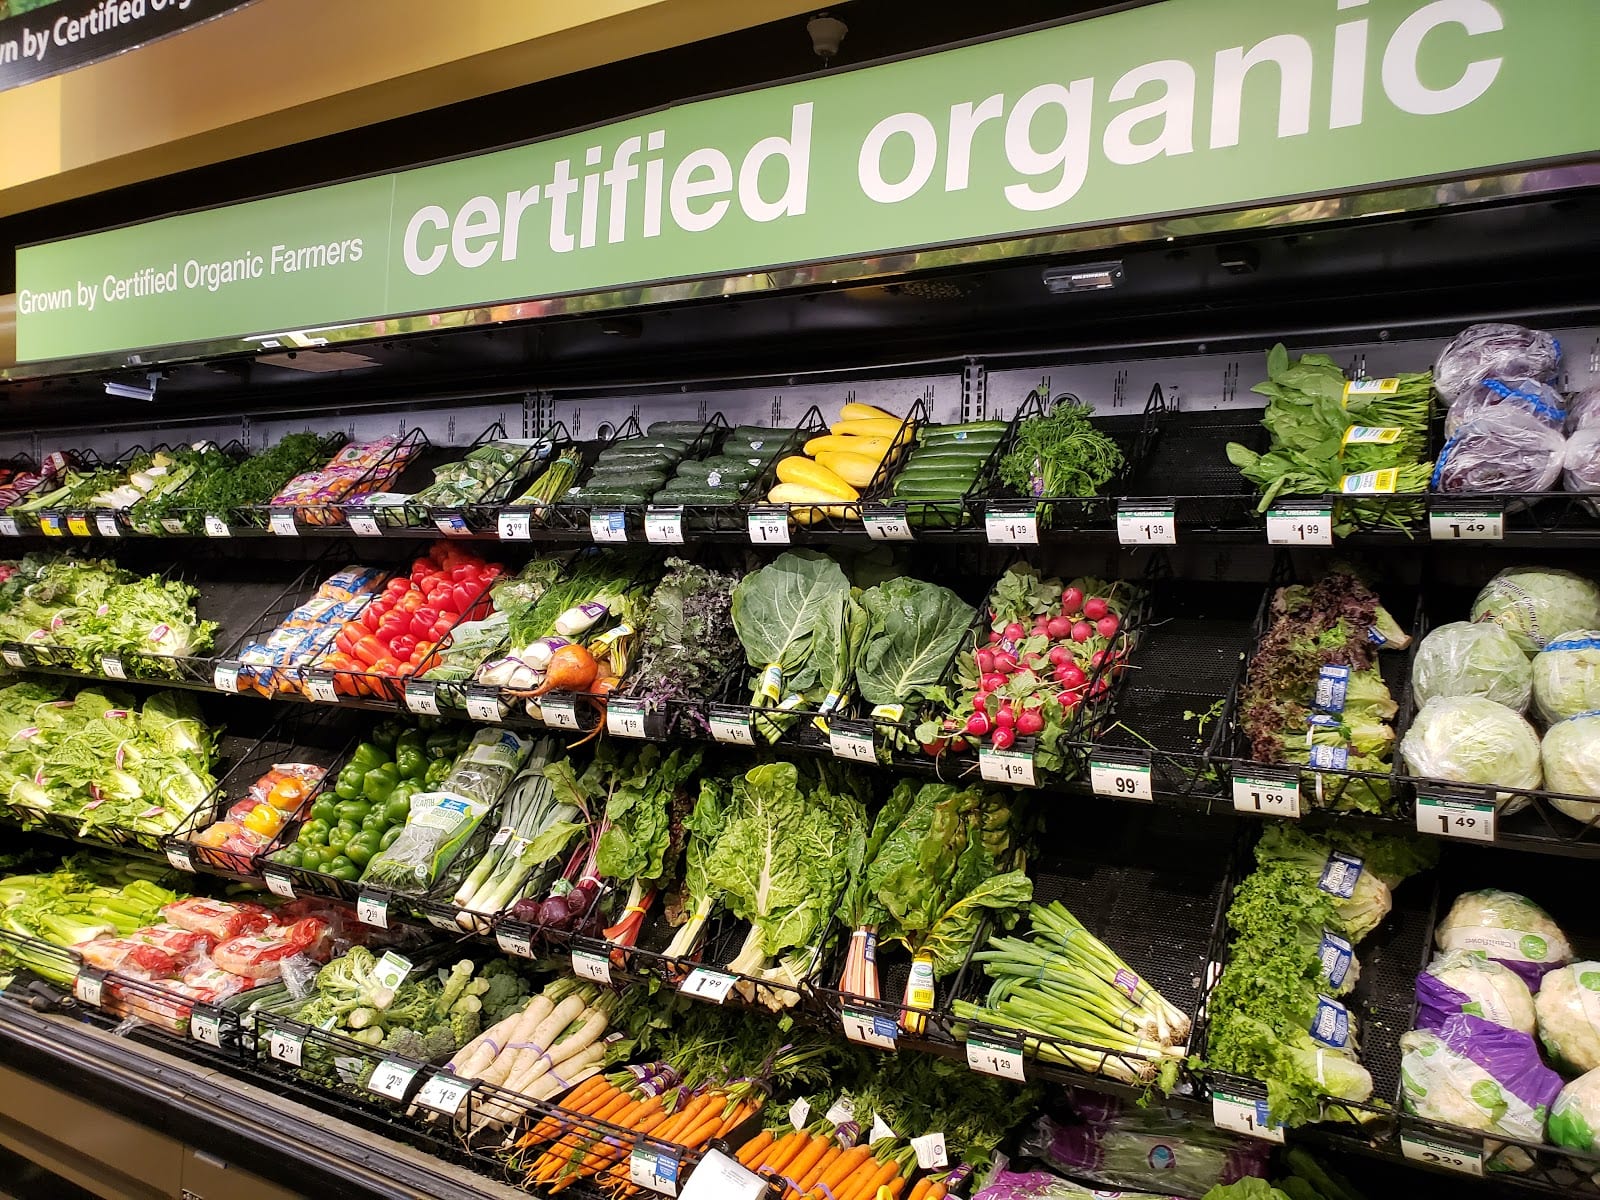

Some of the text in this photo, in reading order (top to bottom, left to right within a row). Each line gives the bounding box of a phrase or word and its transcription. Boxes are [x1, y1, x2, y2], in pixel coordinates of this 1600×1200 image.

[22, 28, 50, 61] by
[53, 0, 146, 47] Certified
[403, 0, 1504, 276] certified organic
[18, 237, 364, 315] Grown by Certified Organic Farmers
[507, 523, 522, 537] 399
[760, 526, 779, 541] 199
[877, 525, 899, 538] 199
[1449, 524, 1486, 538] 149
[1251, 792, 1283, 810] 199
[1438, 815, 1476, 833] 149
